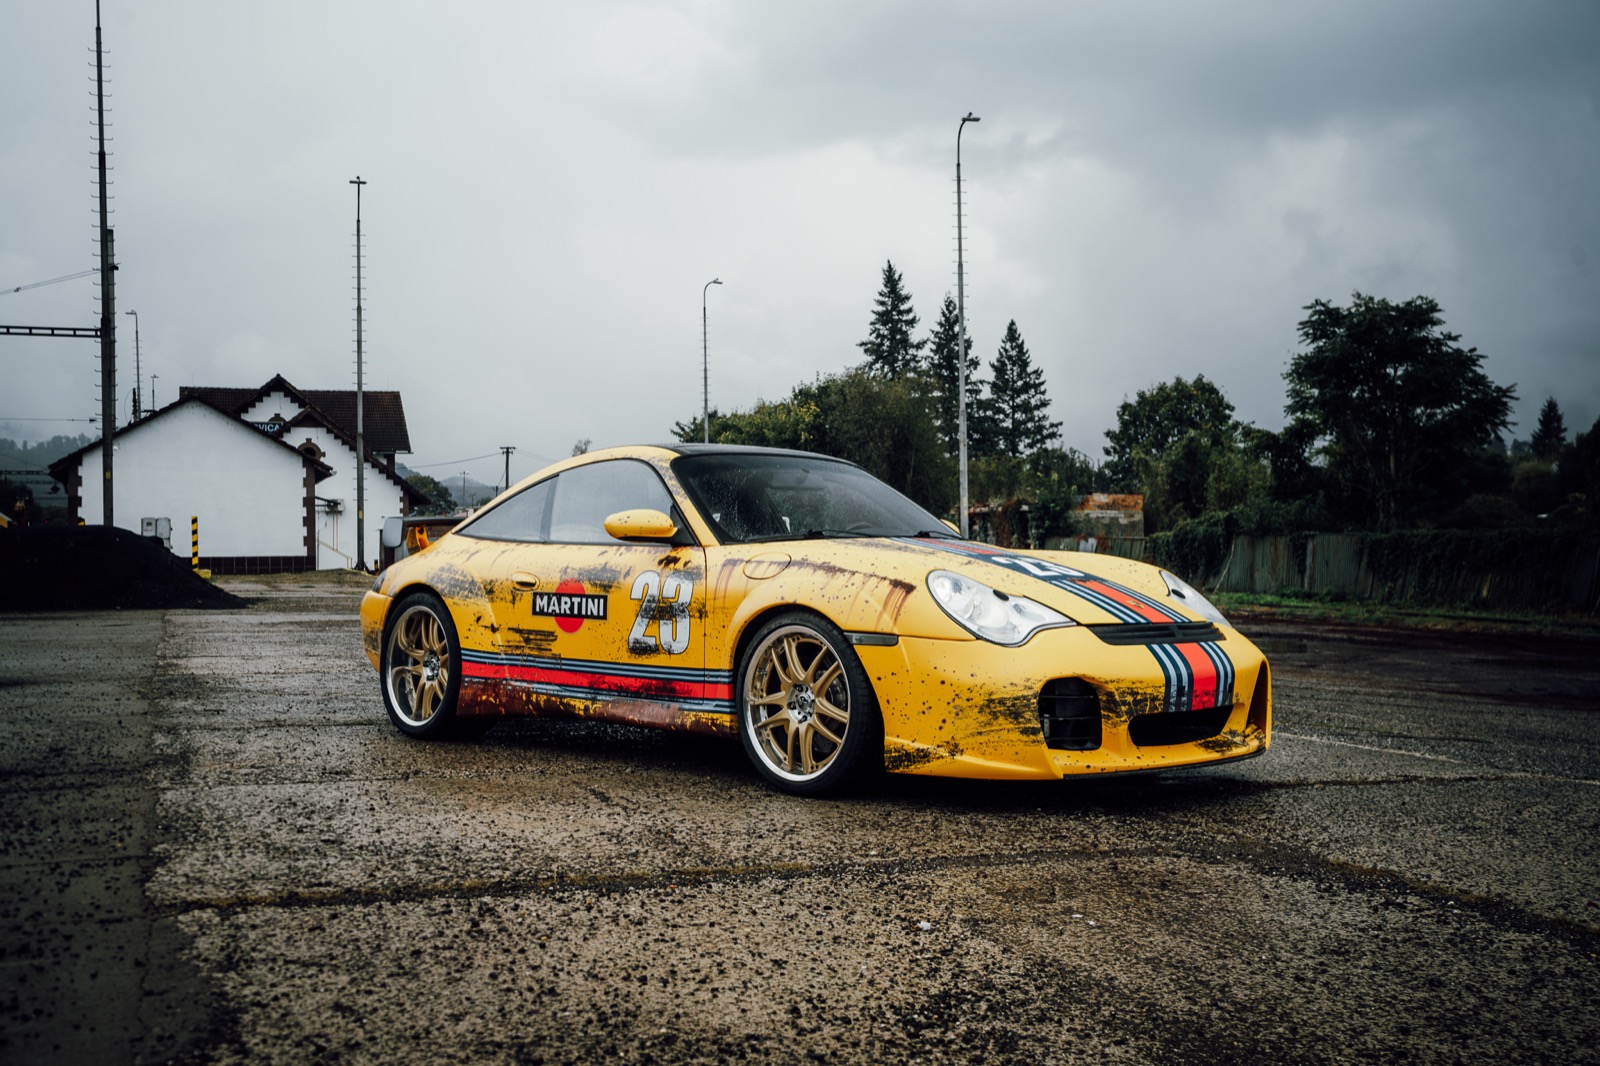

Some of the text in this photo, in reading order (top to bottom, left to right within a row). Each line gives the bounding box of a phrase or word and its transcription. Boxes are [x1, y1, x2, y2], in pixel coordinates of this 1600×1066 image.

[991, 556, 1085, 577] 23
[535, 594, 604, 617] MARTINI
[628, 570, 694, 655] 23
